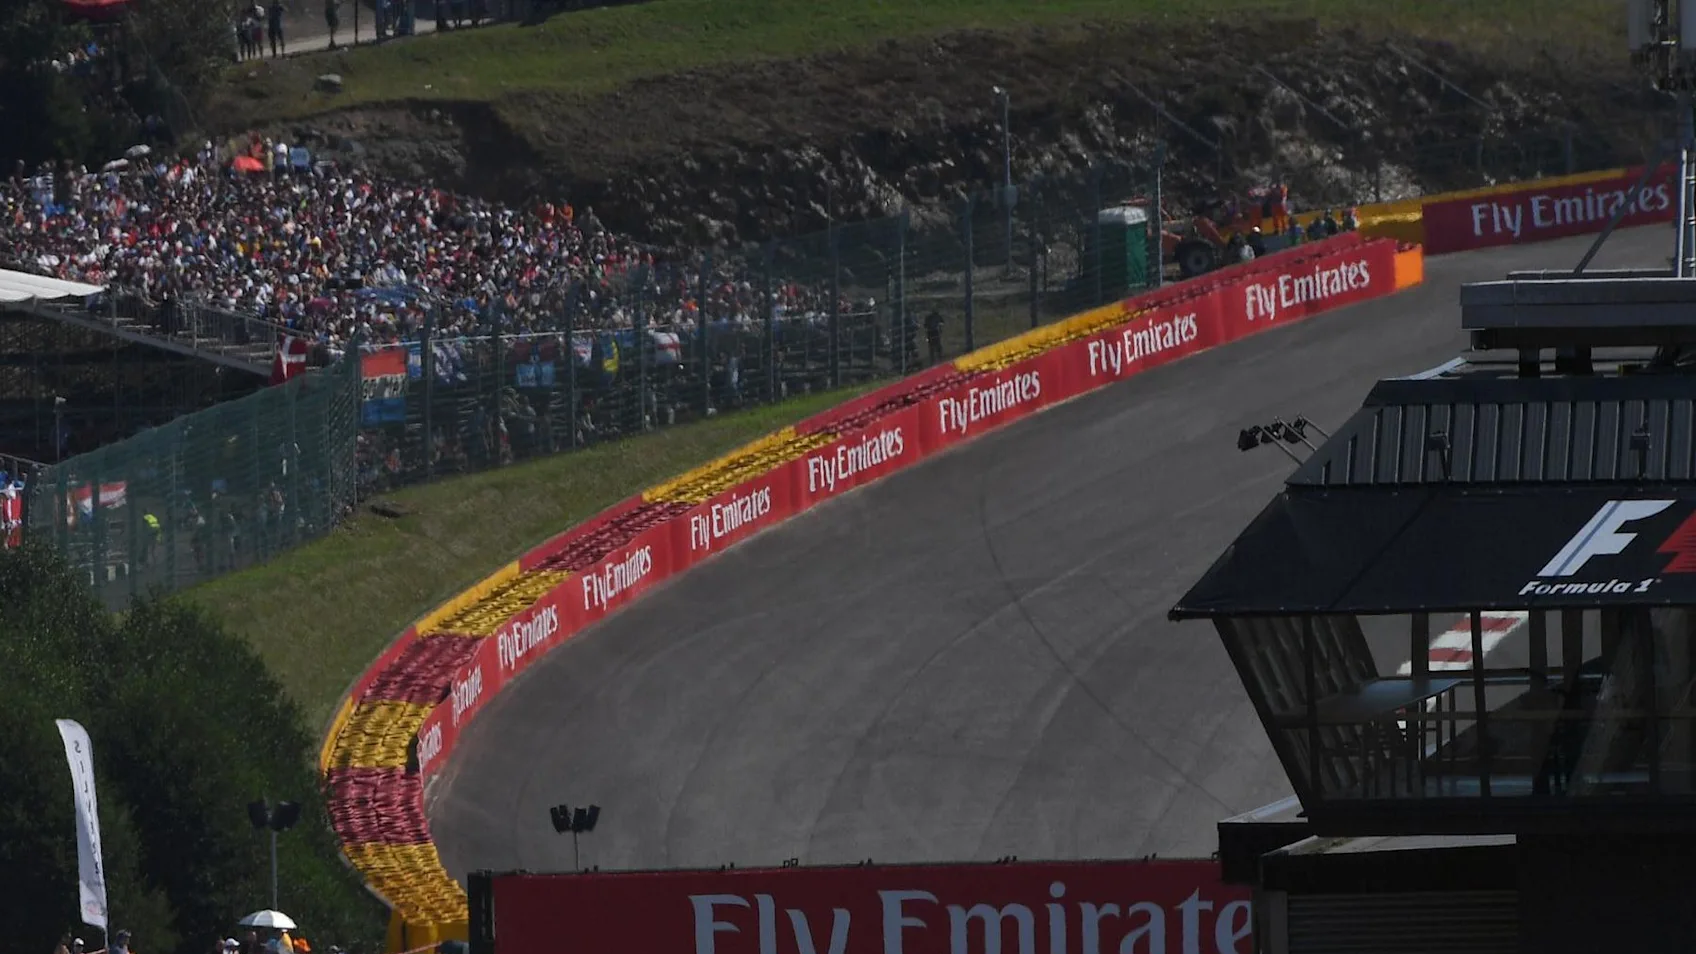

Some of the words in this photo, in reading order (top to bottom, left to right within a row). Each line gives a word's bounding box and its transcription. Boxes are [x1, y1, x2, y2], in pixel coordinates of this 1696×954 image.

[1471, 202, 1523, 238] Fly
[1246, 284, 1276, 320] Fly
[1279, 259, 1371, 310] Emirates
[1088, 339, 1122, 376] Fly
[1123, 311, 1198, 363] Emirates
[939, 397, 969, 435] Fly
[969, 370, 1040, 422] Emirates
[808, 454, 836, 492] Fly
[837, 427, 904, 480] Emirates
[690, 515, 711, 551] Fly
[711, 486, 771, 538] Emirates
[582, 573, 608, 611] Fly
[606, 545, 652, 598] Emirates
[1518, 578, 1633, 596] Formula
[1633, 578, 1655, 593] 1
